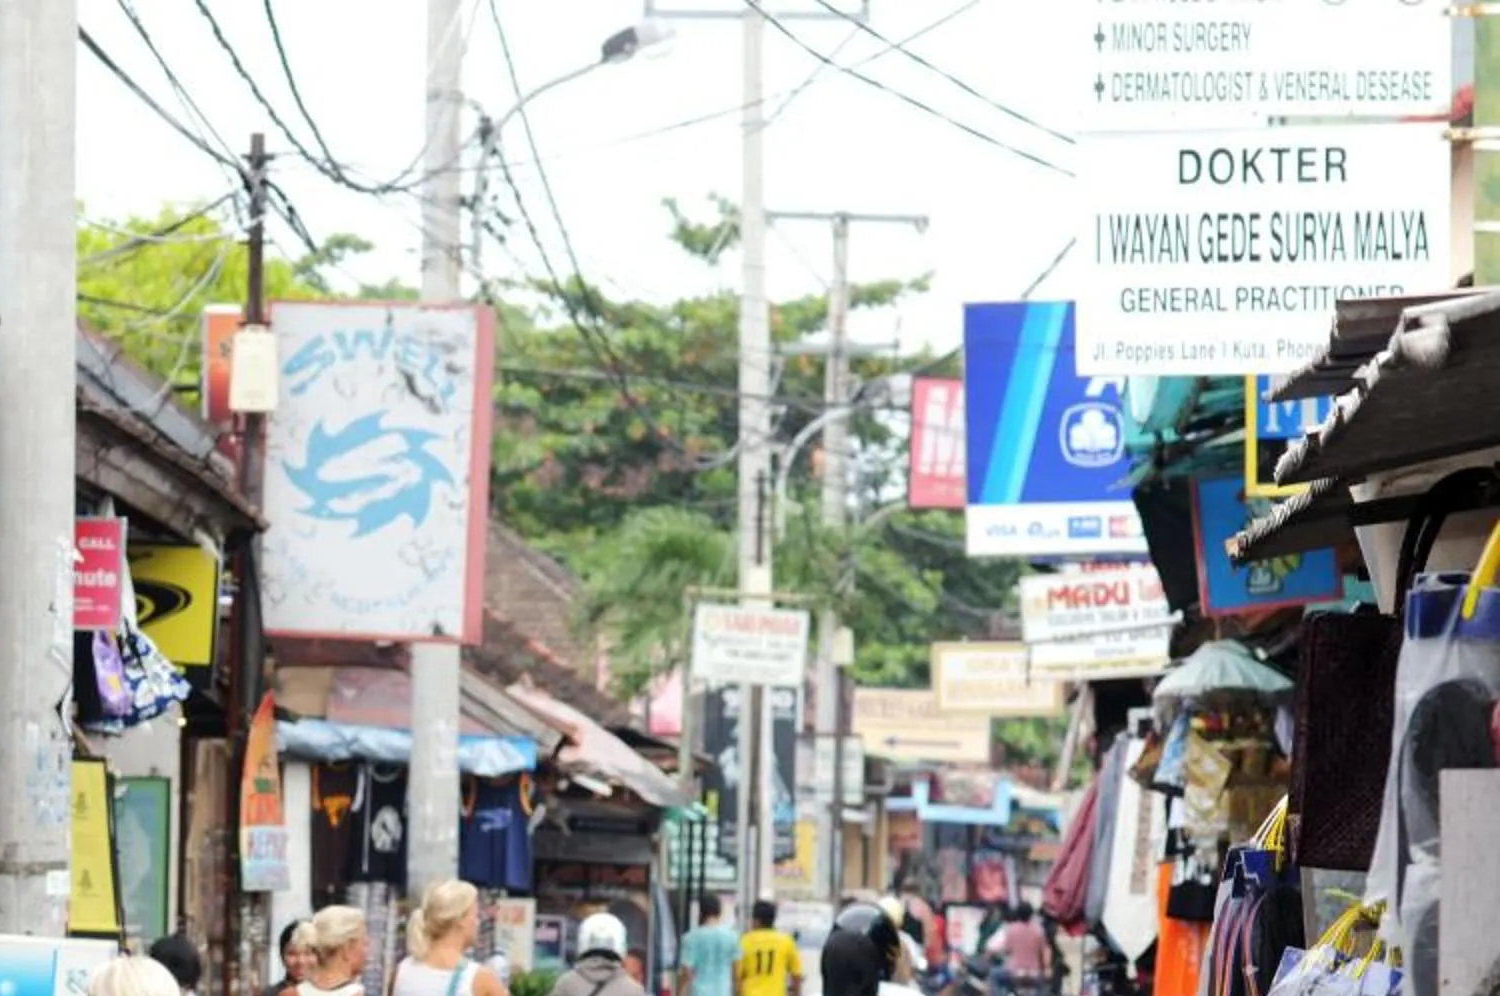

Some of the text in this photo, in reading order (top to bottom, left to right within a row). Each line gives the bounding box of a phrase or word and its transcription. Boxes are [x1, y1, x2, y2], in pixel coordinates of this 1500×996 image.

[1112, 22, 1252, 51] MINOR SURGERY
[1112, 71, 1432, 101] DERMATOLOGIST & VENERAL DESEASE
[1178, 147, 1348, 184] DOKTER
[1109, 213, 1190, 264] WAYAN
[1198, 212, 1261, 263] GEDE
[1270, 211, 1347, 263] SURYA
[1355, 210, 1430, 262] MALYA
[1120, 287, 1228, 313] GENERAL
[1115, 340, 1175, 366] Poppies
[1181, 341, 1216, 361] Lane
[1047, 580, 1131, 611] MADU
[755, 948, 776, 976] 11
